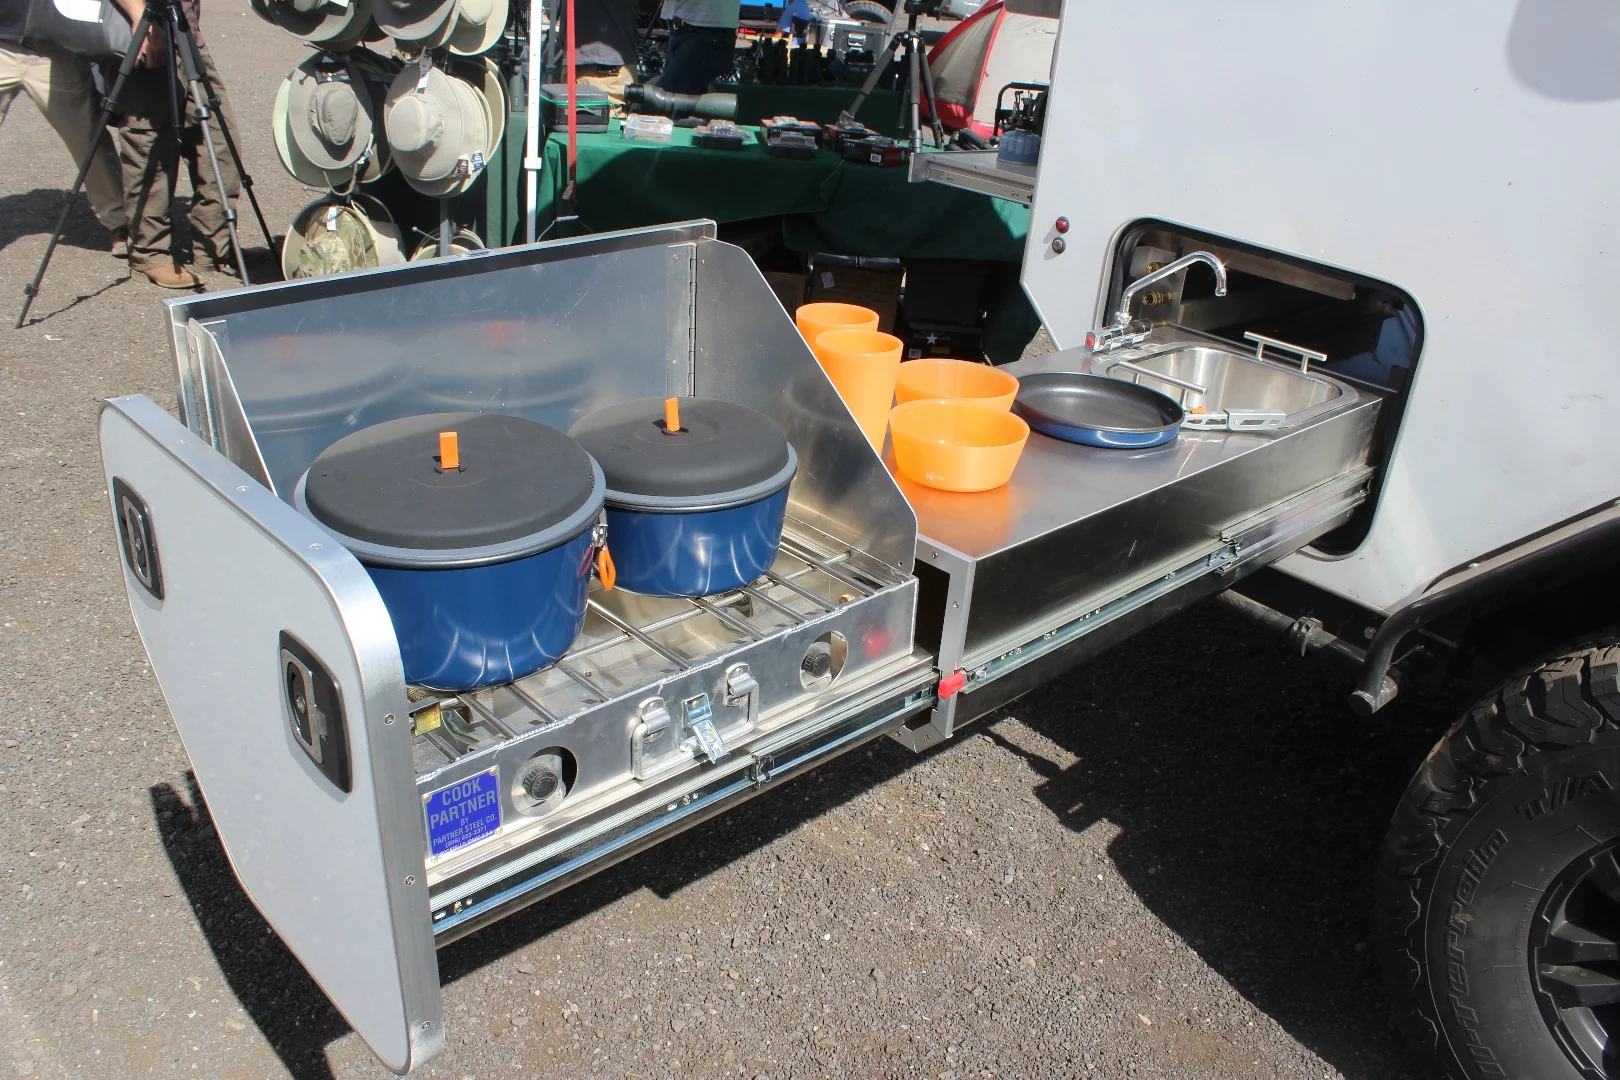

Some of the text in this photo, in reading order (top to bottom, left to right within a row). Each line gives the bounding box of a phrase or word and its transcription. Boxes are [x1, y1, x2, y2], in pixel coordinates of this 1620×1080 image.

[442, 777, 482, 806] COOK
[430, 790, 497, 830] PARTNER
[460, 816, 470, 827] BY
[433, 813, 497, 846] PARTNER STEEL CO.
[1444, 828, 1509, 1080] ll-Terrain
